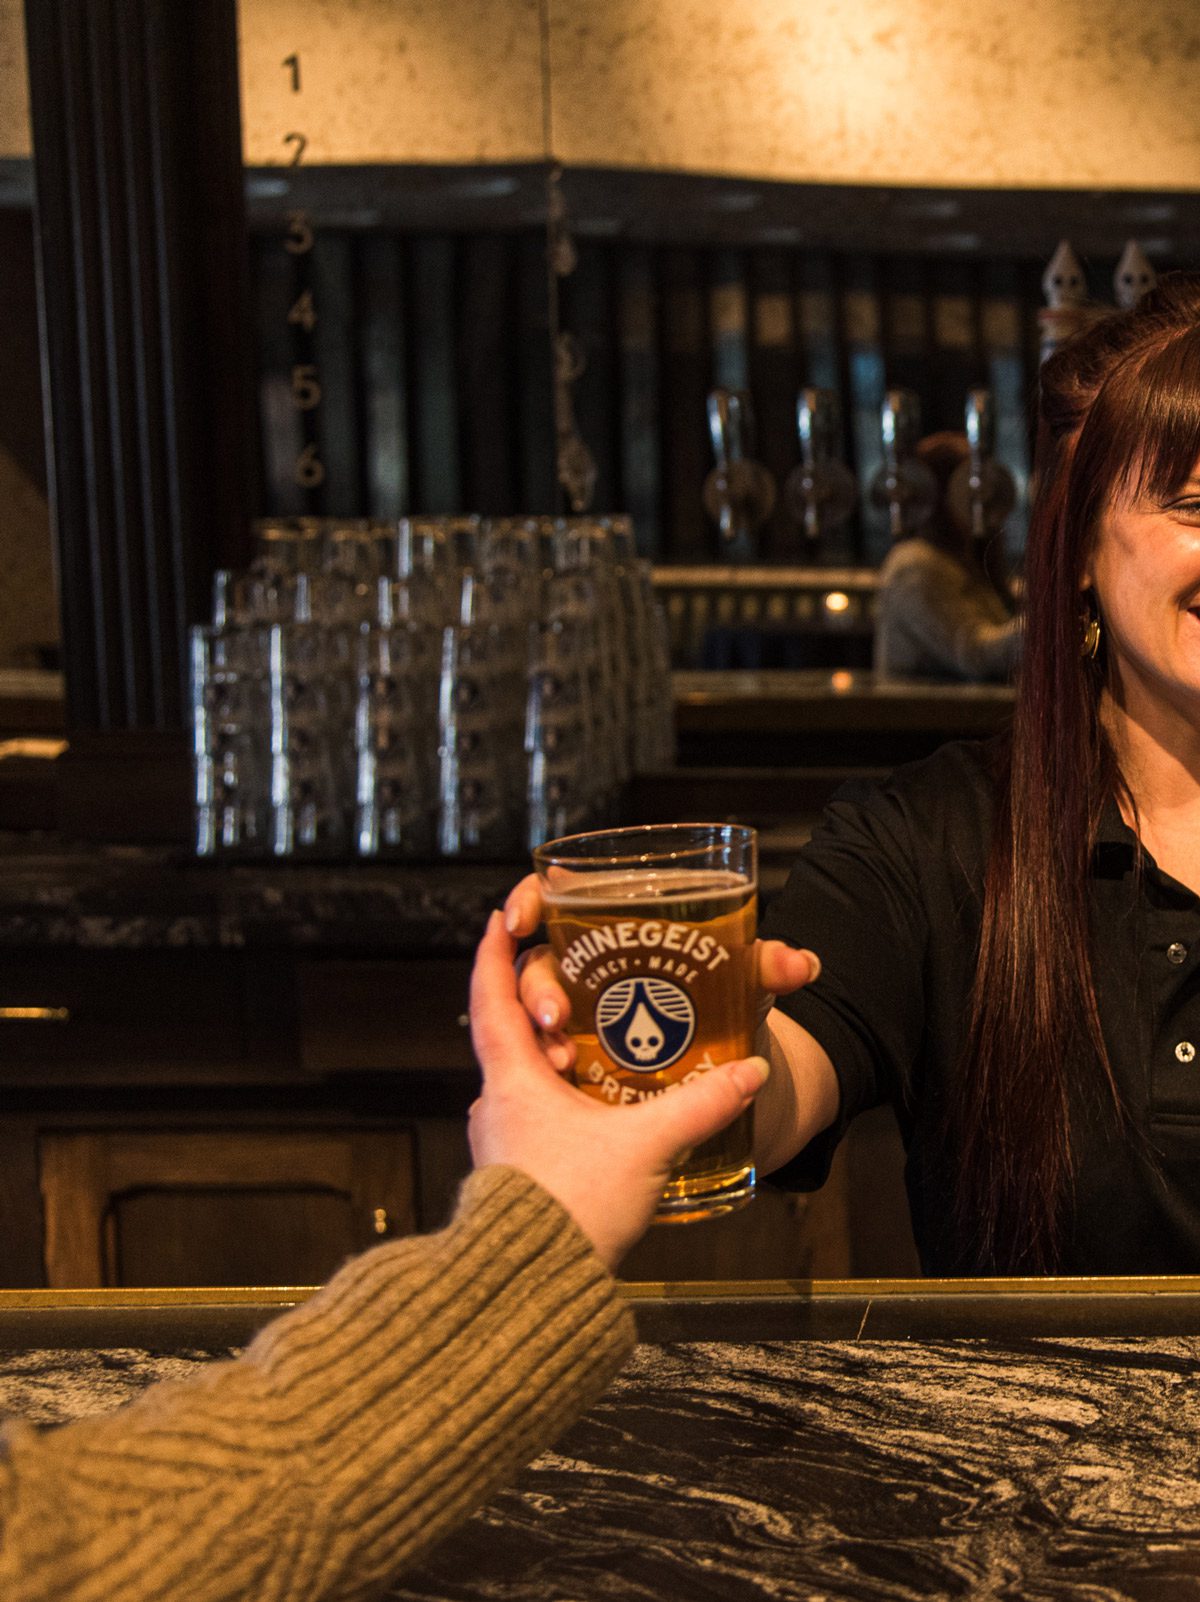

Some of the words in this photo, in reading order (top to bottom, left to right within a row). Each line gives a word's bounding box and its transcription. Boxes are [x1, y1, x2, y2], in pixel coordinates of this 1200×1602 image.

[282, 54, 301, 92] 1
[284, 131, 307, 171] 2
[284, 210, 314, 254] 3
[288, 288, 317, 332] 4
[291, 362, 321, 412] 5
[295, 442, 325, 488] 6
[561, 921, 730, 983] RHINEGEIST
[585, 957, 628, 990] CINCY
[648, 955, 699, 985] MADE
[588, 1052, 715, 1103] BREWY
